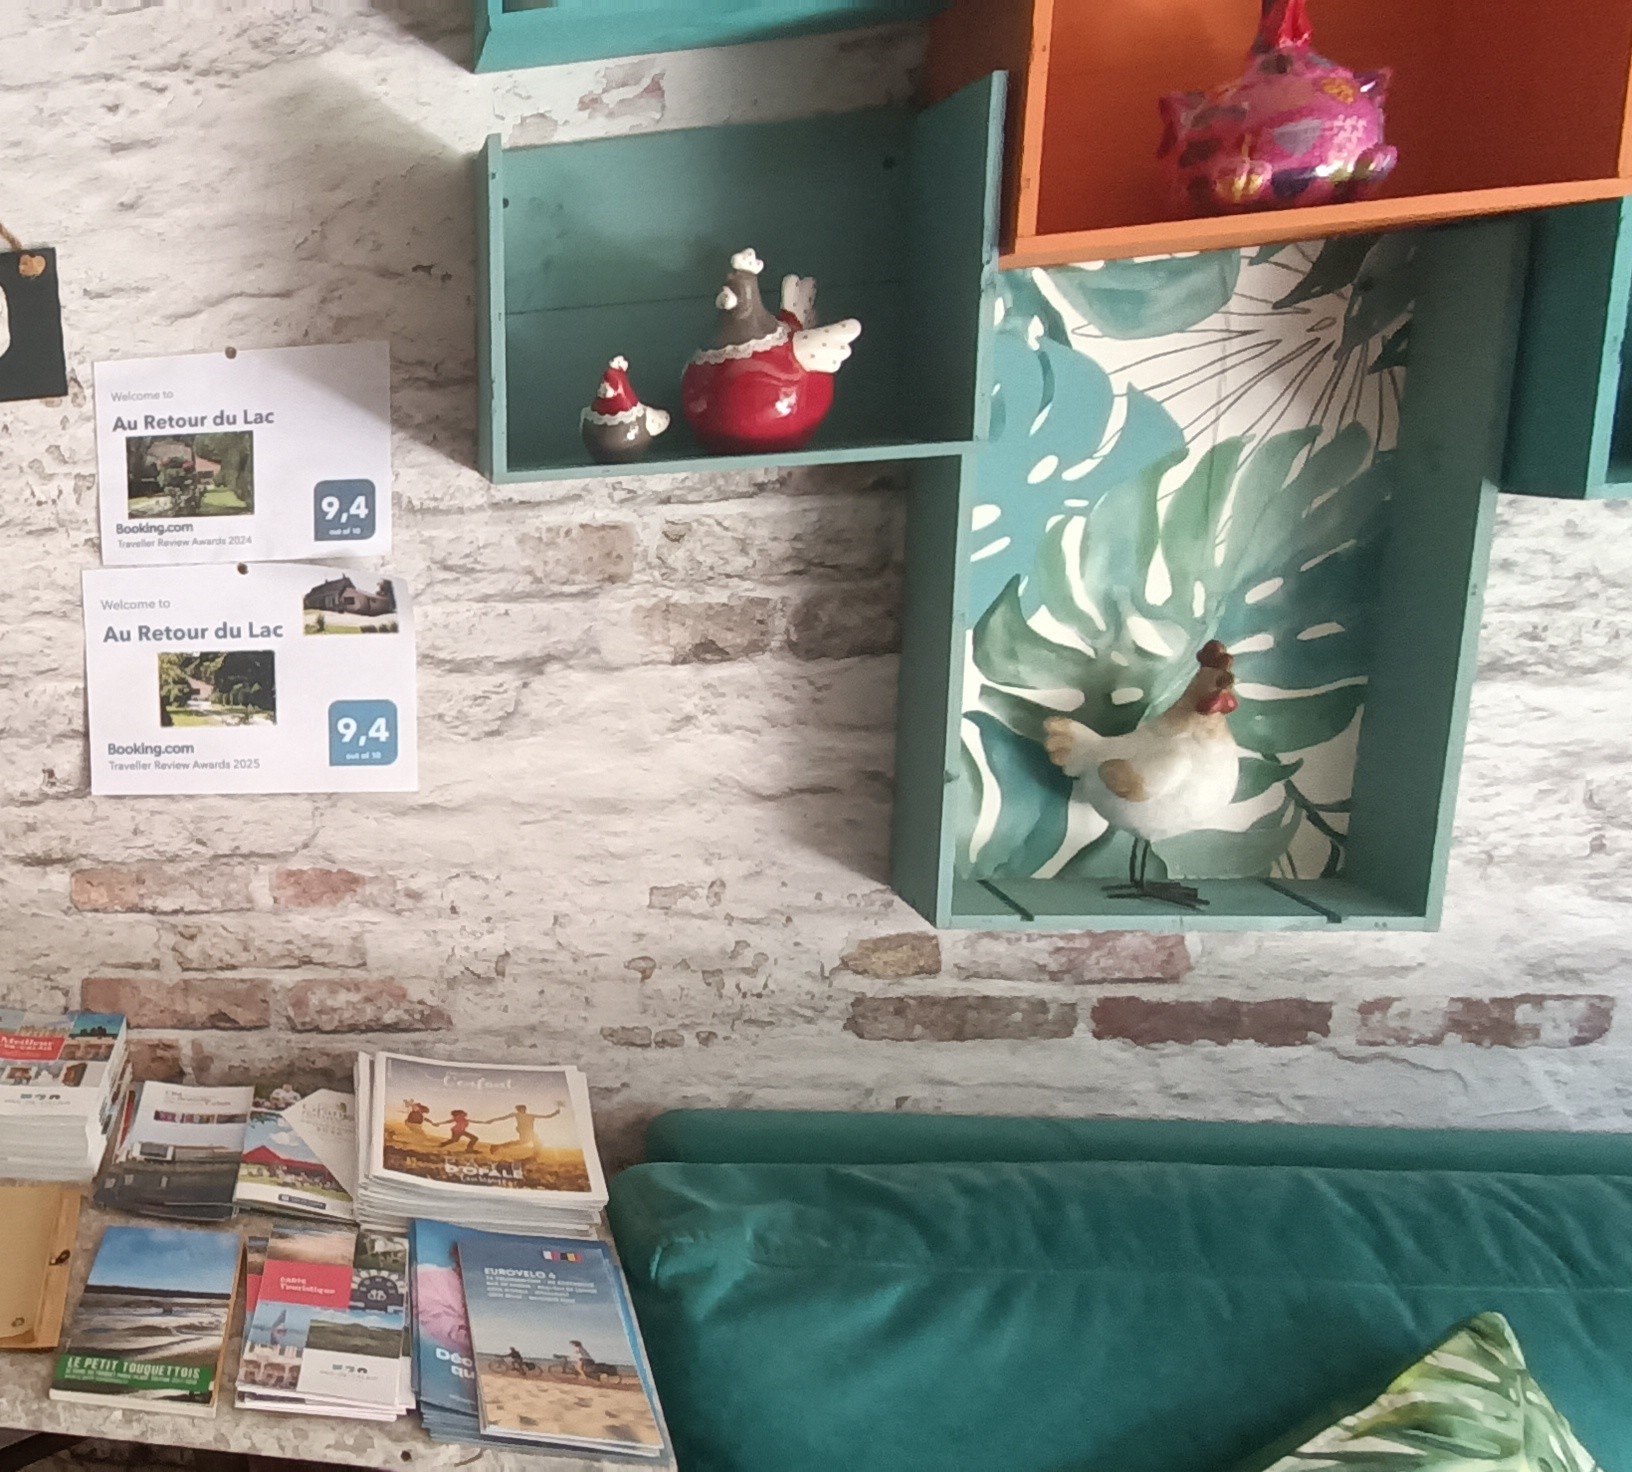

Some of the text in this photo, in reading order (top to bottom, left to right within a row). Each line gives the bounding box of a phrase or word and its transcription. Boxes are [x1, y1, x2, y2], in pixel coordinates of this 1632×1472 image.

[111, 389, 174, 402] Welcome to
[112, 408, 275, 432] Au Retour du Lac
[320, 495, 369, 523] 9,4
[116, 521, 194, 537] Booking.com
[117, 535, 252, 549] Traveller Review Awards 2024
[100, 598, 171, 611] Welcome to
[103, 621, 284, 643] Au Retour du Lac
[336, 717, 390, 747] 9,4
[107, 742, 195, 757] Booking.com
[108, 758, 261, 771] Traveller Review Awards 2025
[484, 1267, 546, 1279] EUROVELO
[68, 1356, 80, 1368] LE
[83, 1358, 118, 1371] PETIT
[123, 1362, 200, 1379] TOUQUETTOIS
